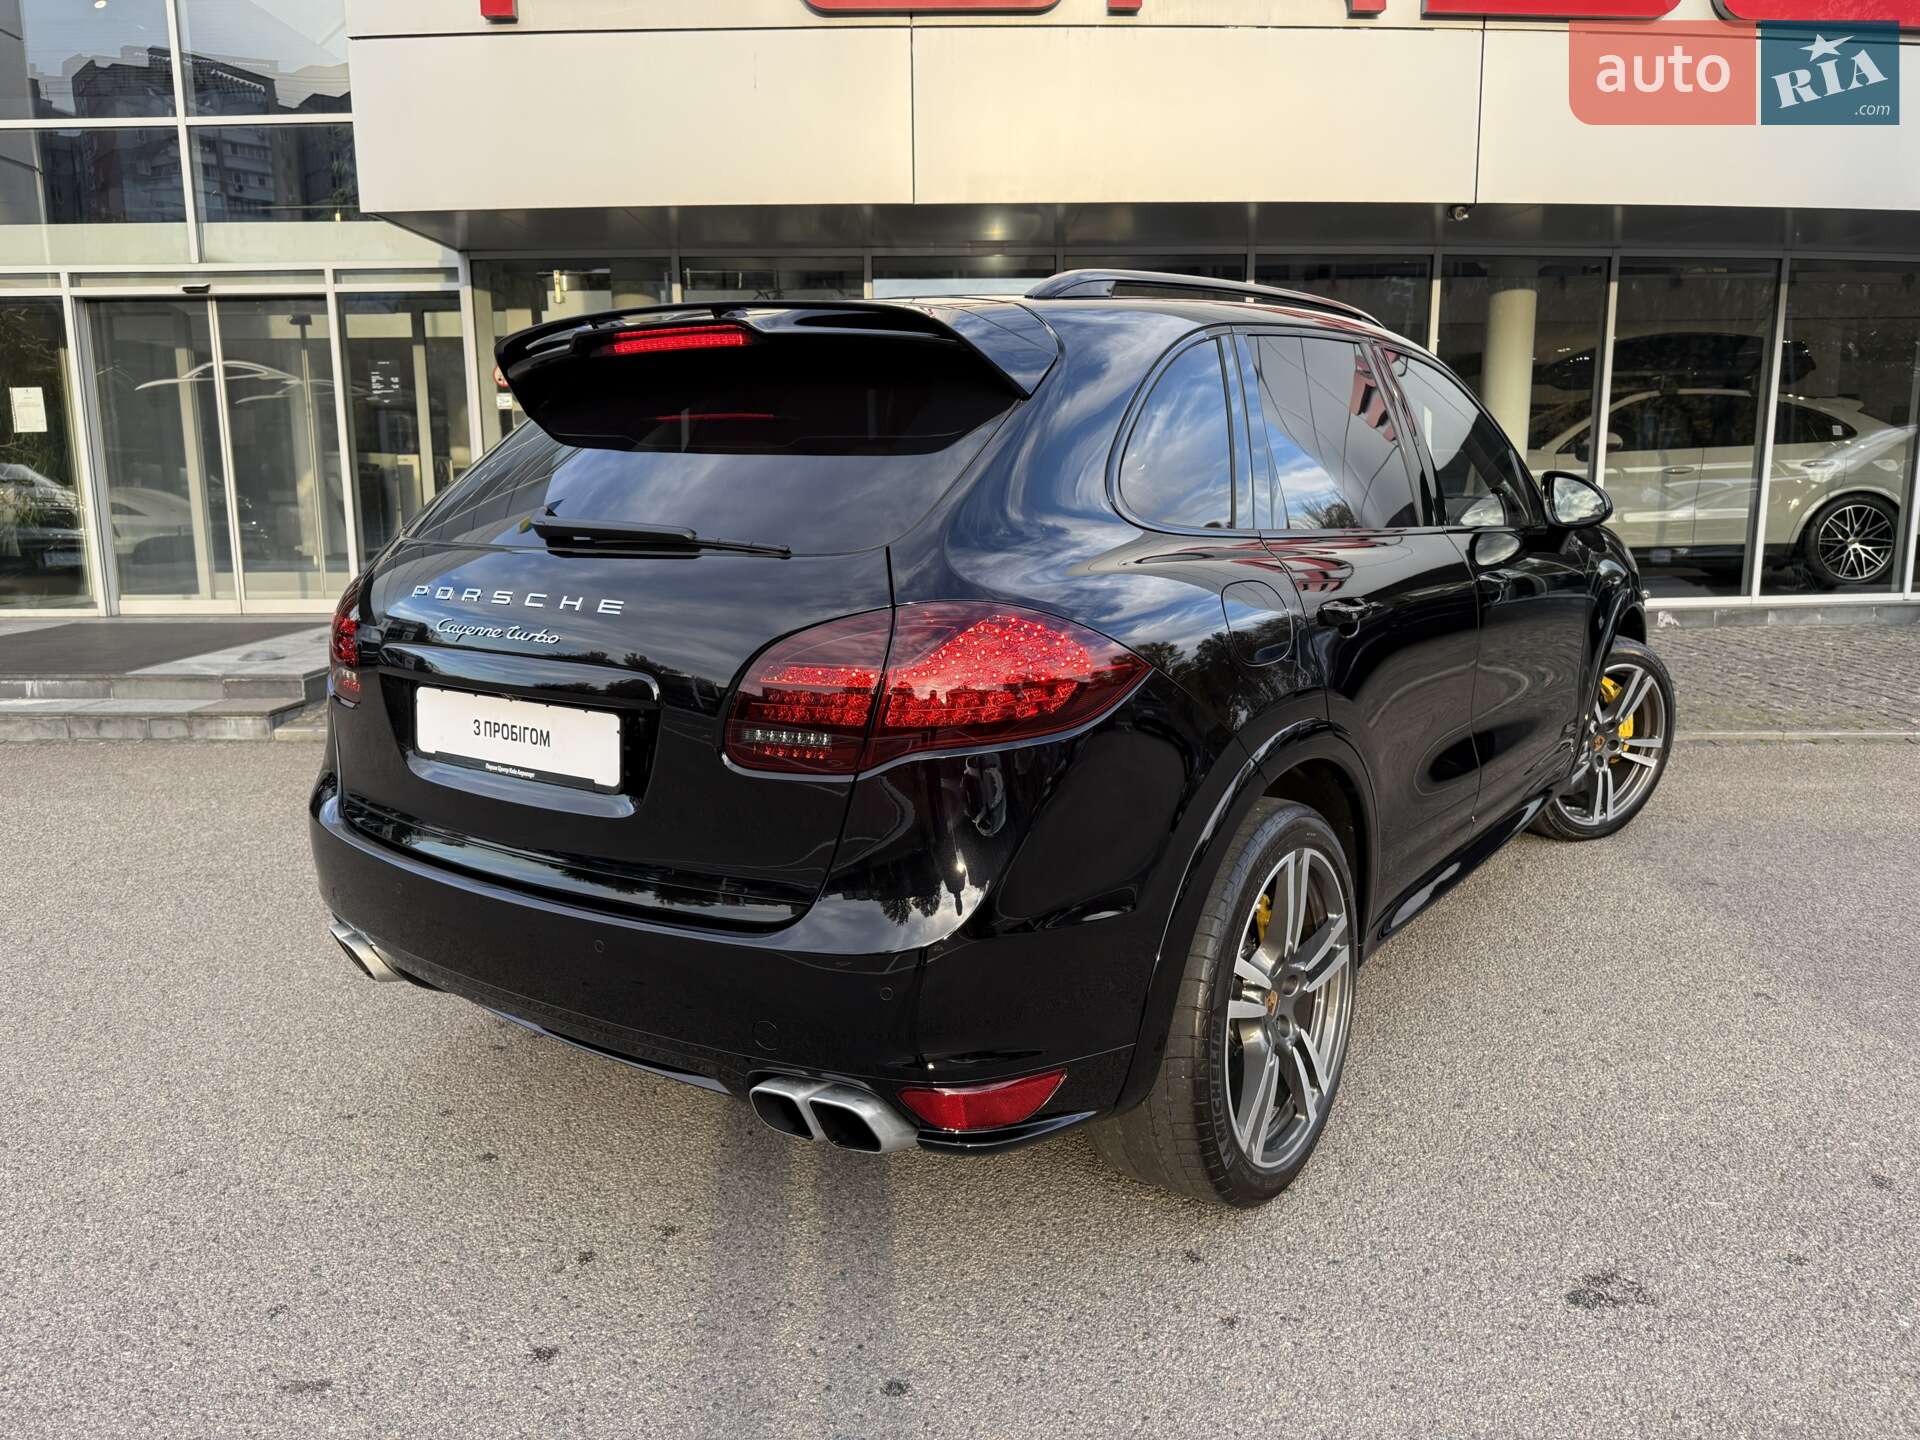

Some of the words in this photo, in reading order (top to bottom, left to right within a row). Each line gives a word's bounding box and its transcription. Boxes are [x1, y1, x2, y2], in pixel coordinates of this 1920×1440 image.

[411, 585, 624, 615] PORSCHE
[437, 617, 503, 642] Cayenne
[506, 625, 560, 644] turbo
[484, 720, 551, 748] ПРОБІГОМ
[1210, 1015, 1228, 1146] MICHELIN
